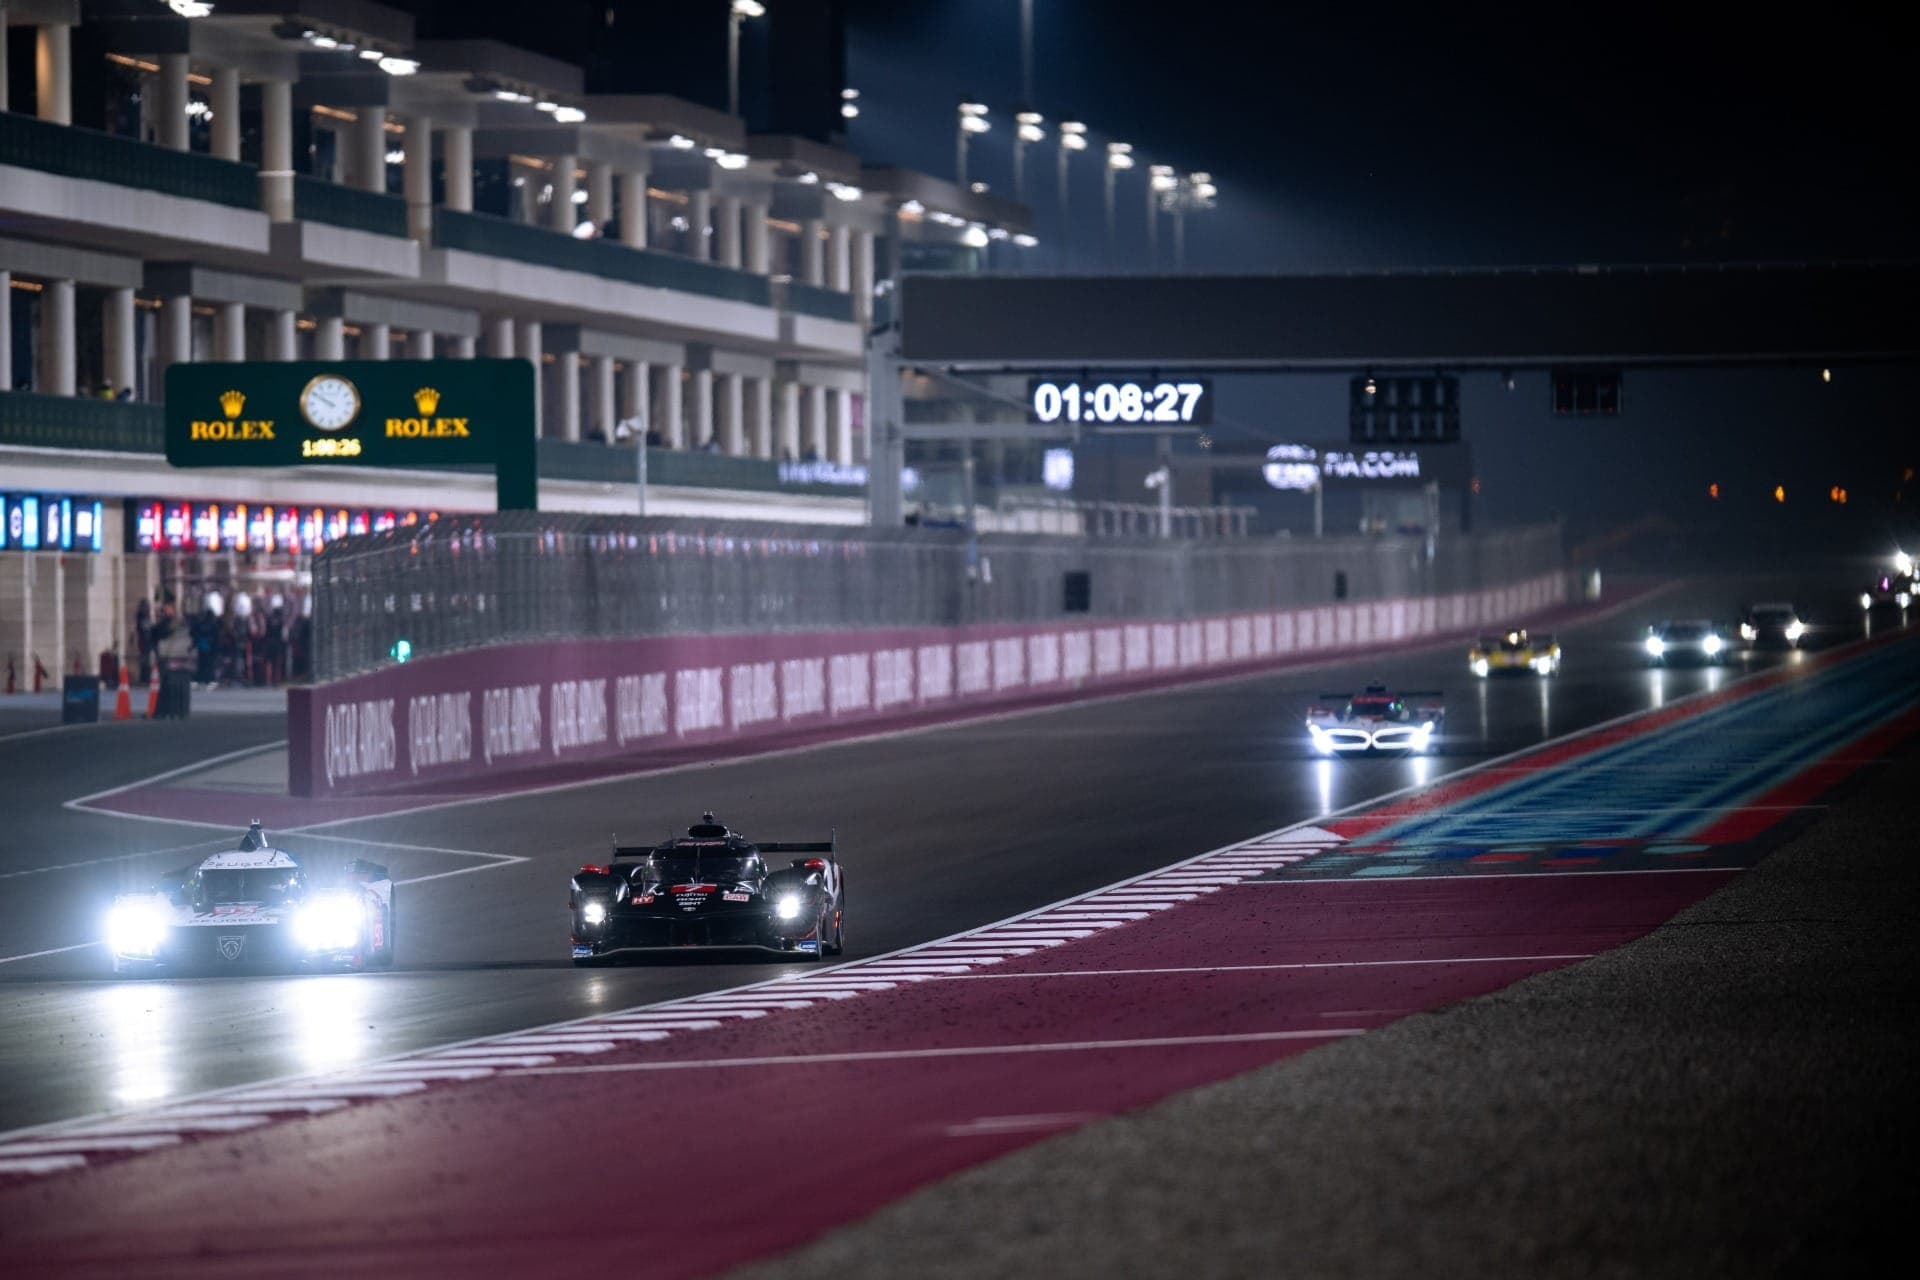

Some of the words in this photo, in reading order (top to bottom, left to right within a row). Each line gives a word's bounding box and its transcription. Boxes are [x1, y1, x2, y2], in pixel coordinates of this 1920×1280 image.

[1033, 382, 1203, 422] 01:08:27
[190, 420, 276, 441] ROLEX
[385, 417, 471, 438] ROLEX
